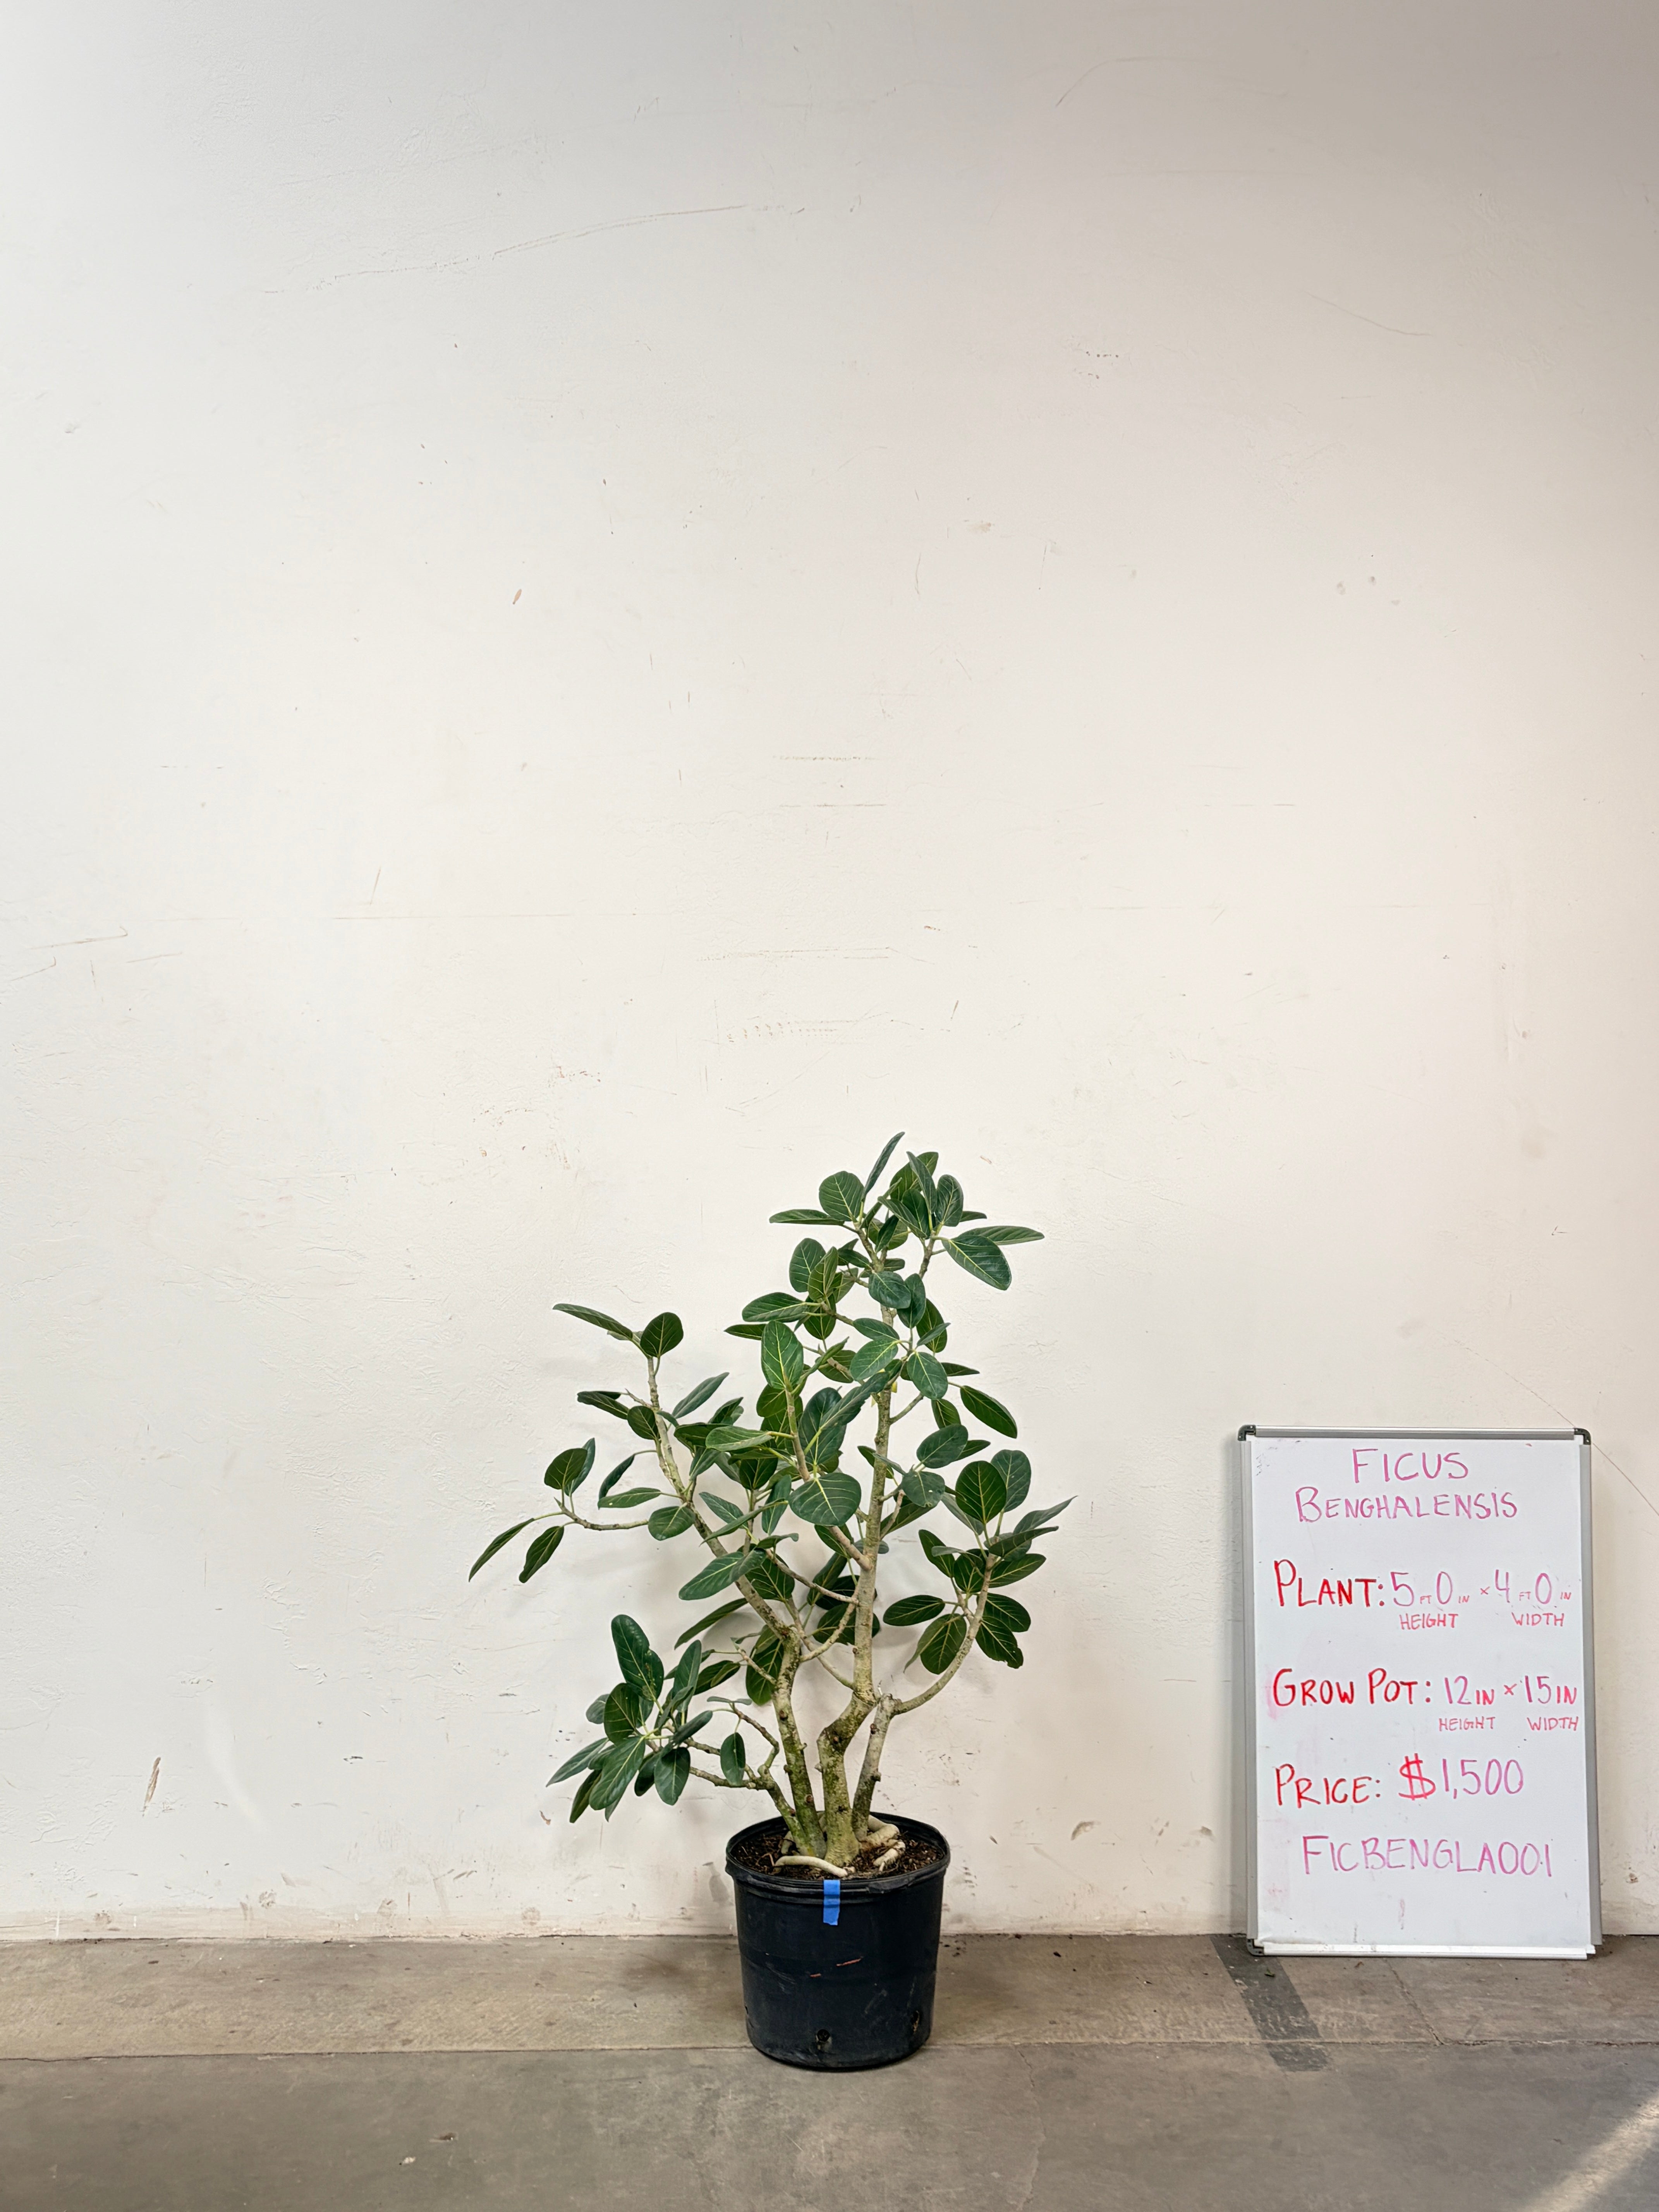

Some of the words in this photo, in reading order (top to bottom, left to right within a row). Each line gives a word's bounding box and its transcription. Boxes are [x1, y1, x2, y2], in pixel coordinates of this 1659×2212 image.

[1352, 1448, 1469, 1484] FICUS
[1295, 1486, 1518, 1523] BENGHALENSIS
[1273, 1559, 1385, 1608] PLANT:
[1399, 1613, 1458, 1631] HEIGHT
[1511, 1612, 1565, 1627] WIDTH
[1272, 1668, 1355, 1706] GROW
[1367, 1667, 1431, 1705] POT:
[1438, 1716, 1495, 1732] HEIGHT
[1527, 1716, 1579, 1731] WIDTH
[1275, 1763, 1381, 1809] PRICE:
[1398, 1752, 1524, 1802] $1,500
